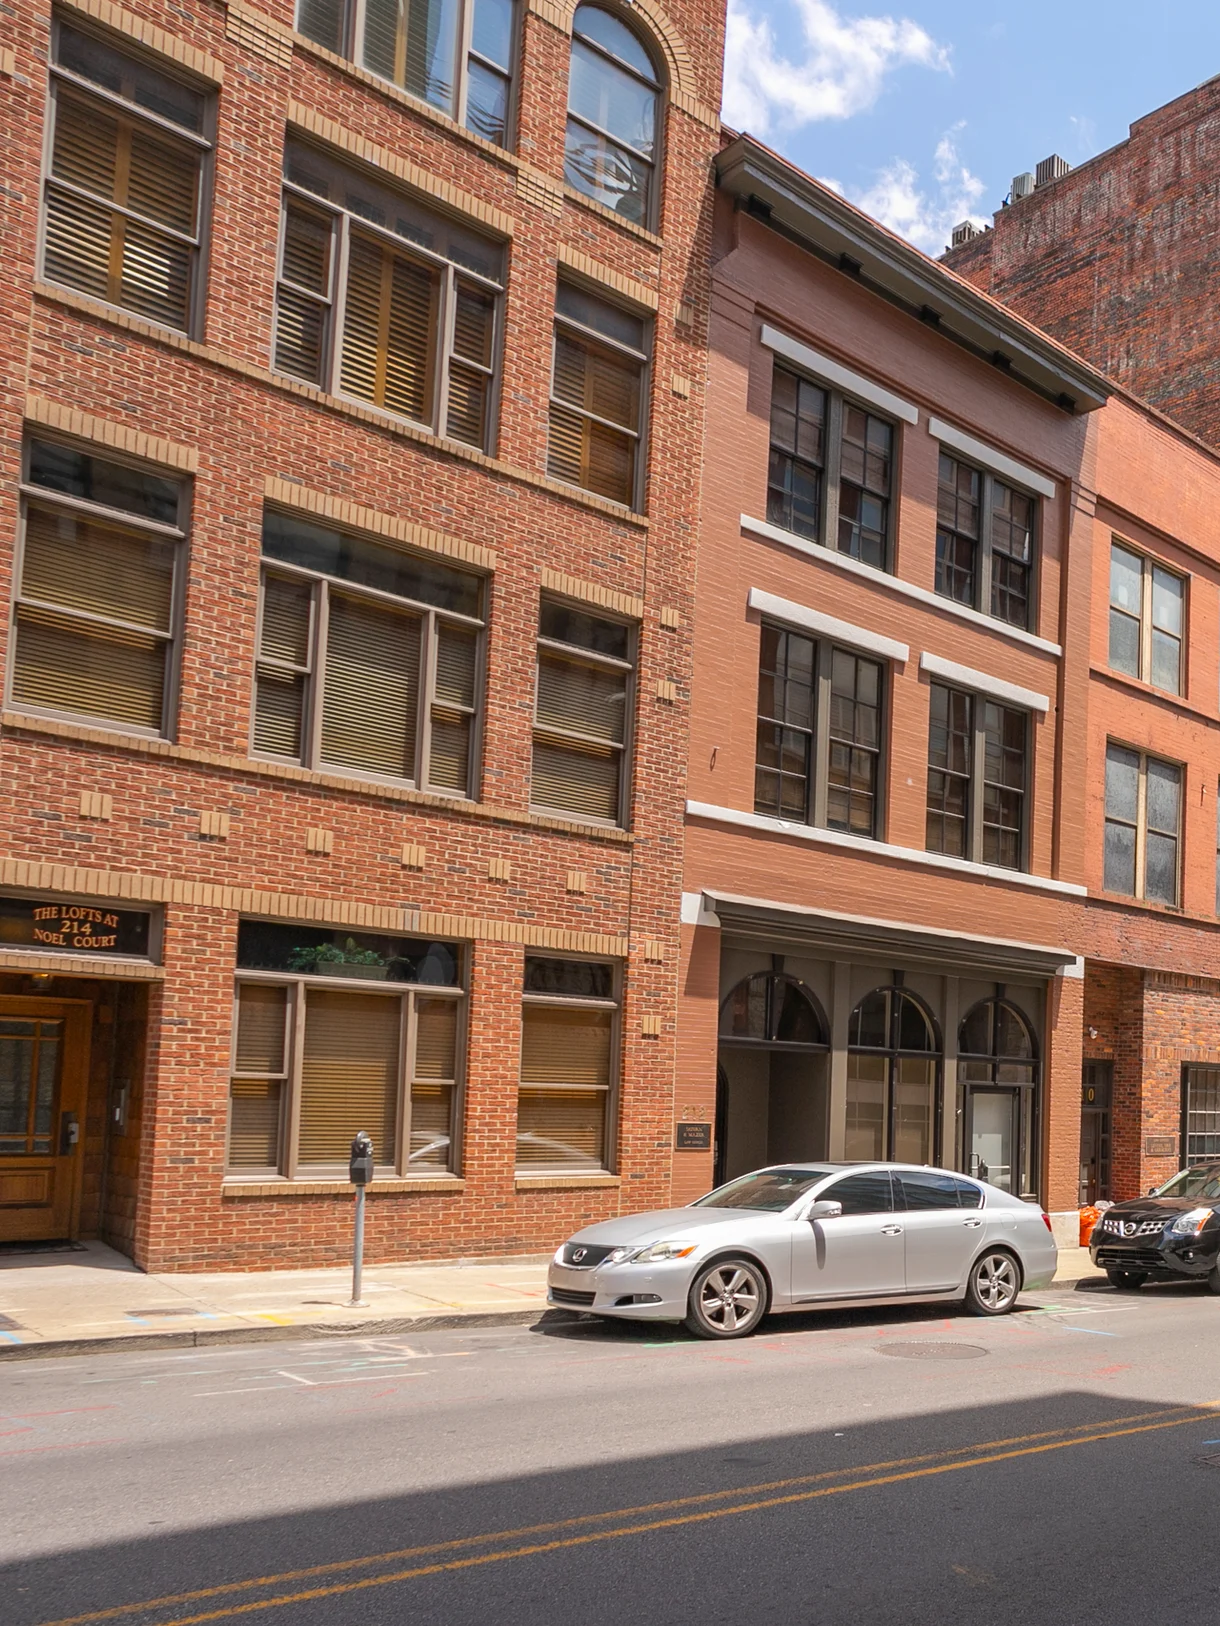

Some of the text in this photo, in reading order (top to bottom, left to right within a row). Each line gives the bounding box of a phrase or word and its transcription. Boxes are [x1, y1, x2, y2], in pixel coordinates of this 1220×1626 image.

[34, 906, 120, 928] THE LOFTS AT
[60, 920, 93, 935] 214
[33, 928, 117, 948] NOEL COURT
